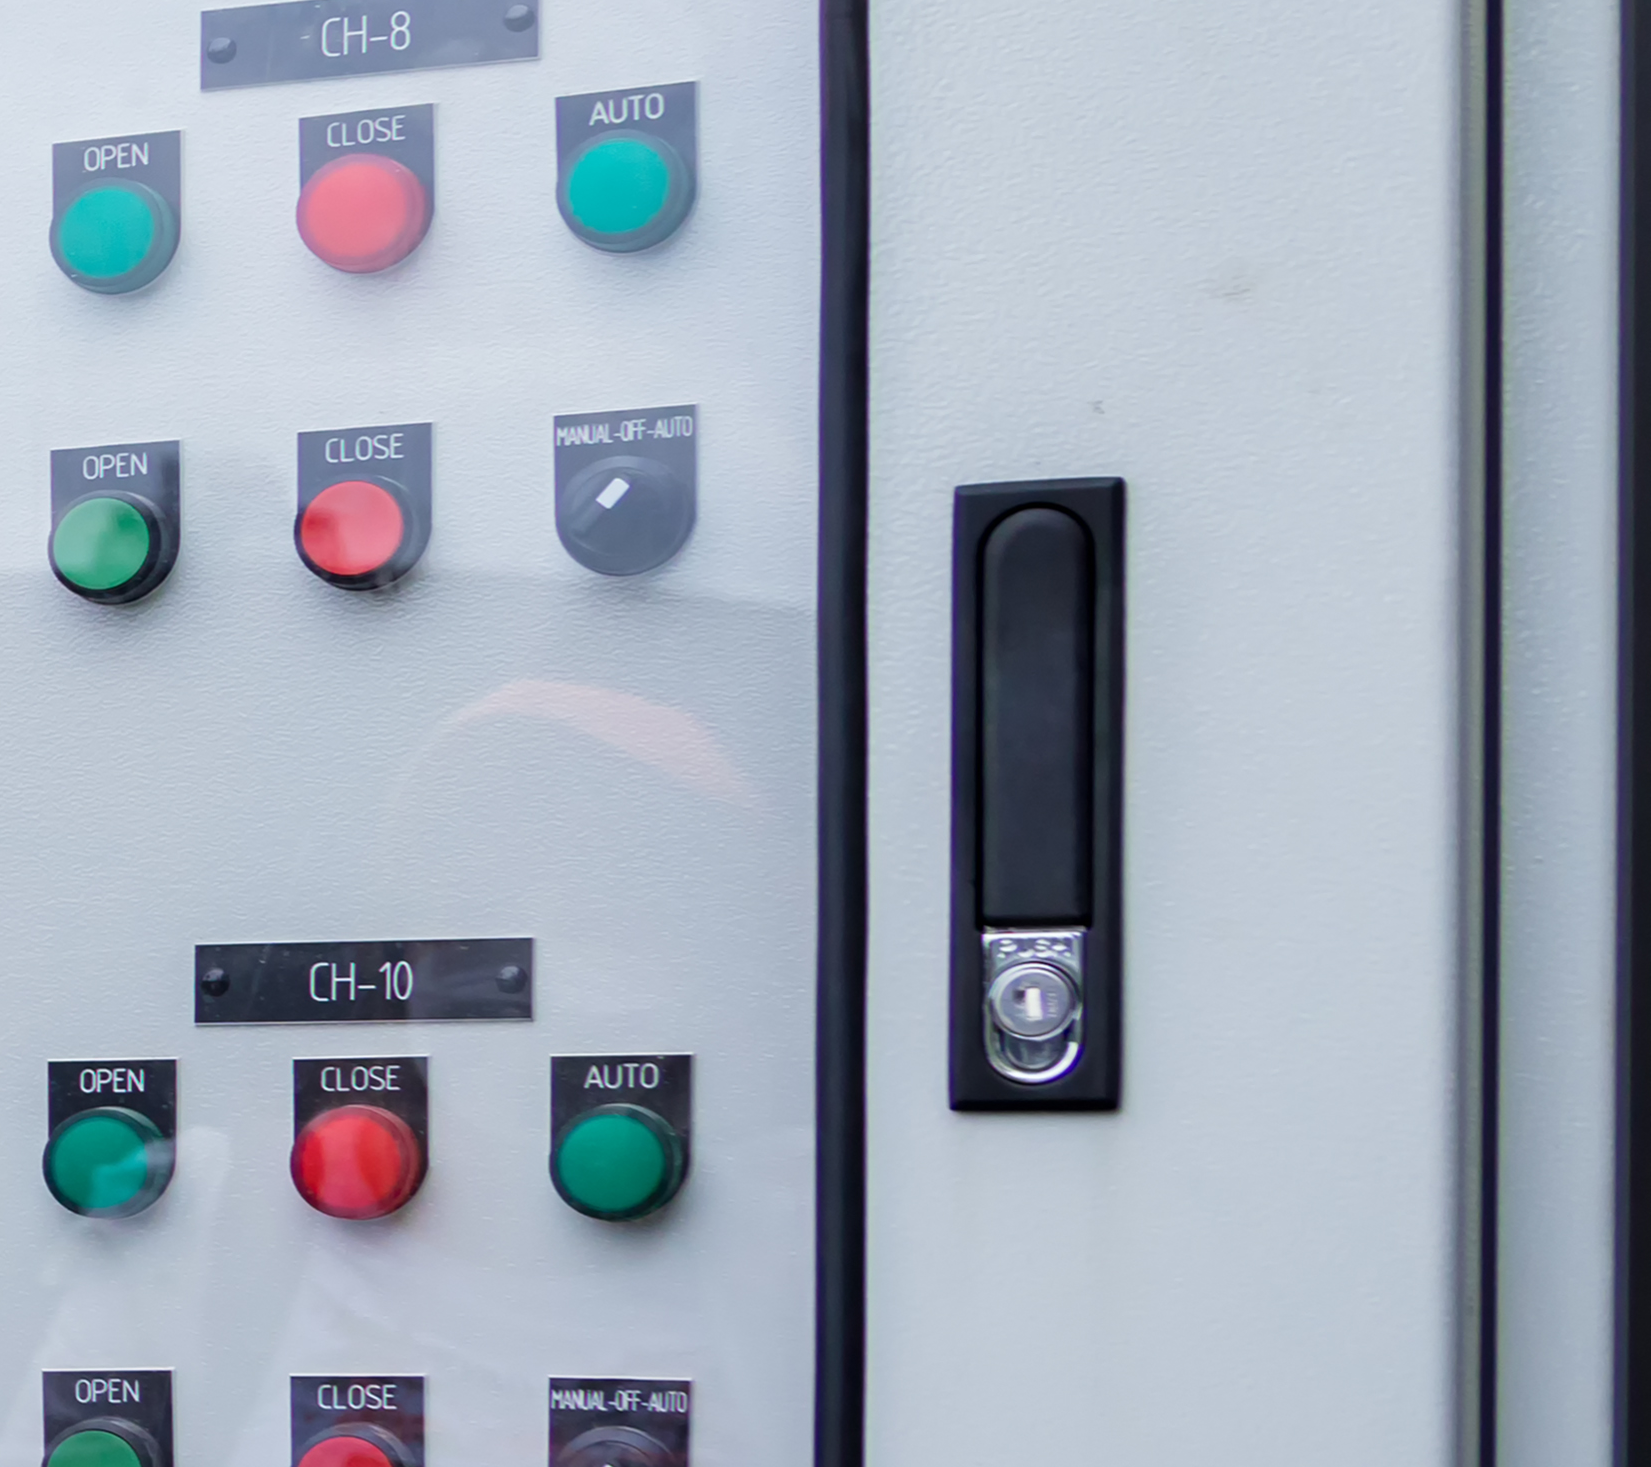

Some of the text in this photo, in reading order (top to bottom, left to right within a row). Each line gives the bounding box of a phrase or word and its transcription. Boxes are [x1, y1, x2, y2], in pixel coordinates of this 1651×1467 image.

[321, 10, 411, 58] CH-8
[588, 92, 665, 126] AUTO
[326, 114, 406, 148] CLOSE
[83, 142, 149, 172] OPEN
[556, 415, 693, 447] MANUAL-OFF-AUTO
[325, 432, 404, 464] CLOSE
[82, 452, 148, 480] OPEN
[309, 960, 413, 1002] CH-10
[79, 1067, 145, 1094] OPEN
[320, 1064, 401, 1092] CLOSE
[583, 1062, 659, 1090] AUTO
[75, 1378, 140, 1404] OPEN
[317, 1384, 398, 1410] CLOSE
[550, 1389, 688, 1413] MANUAL-OFF-AUTO
